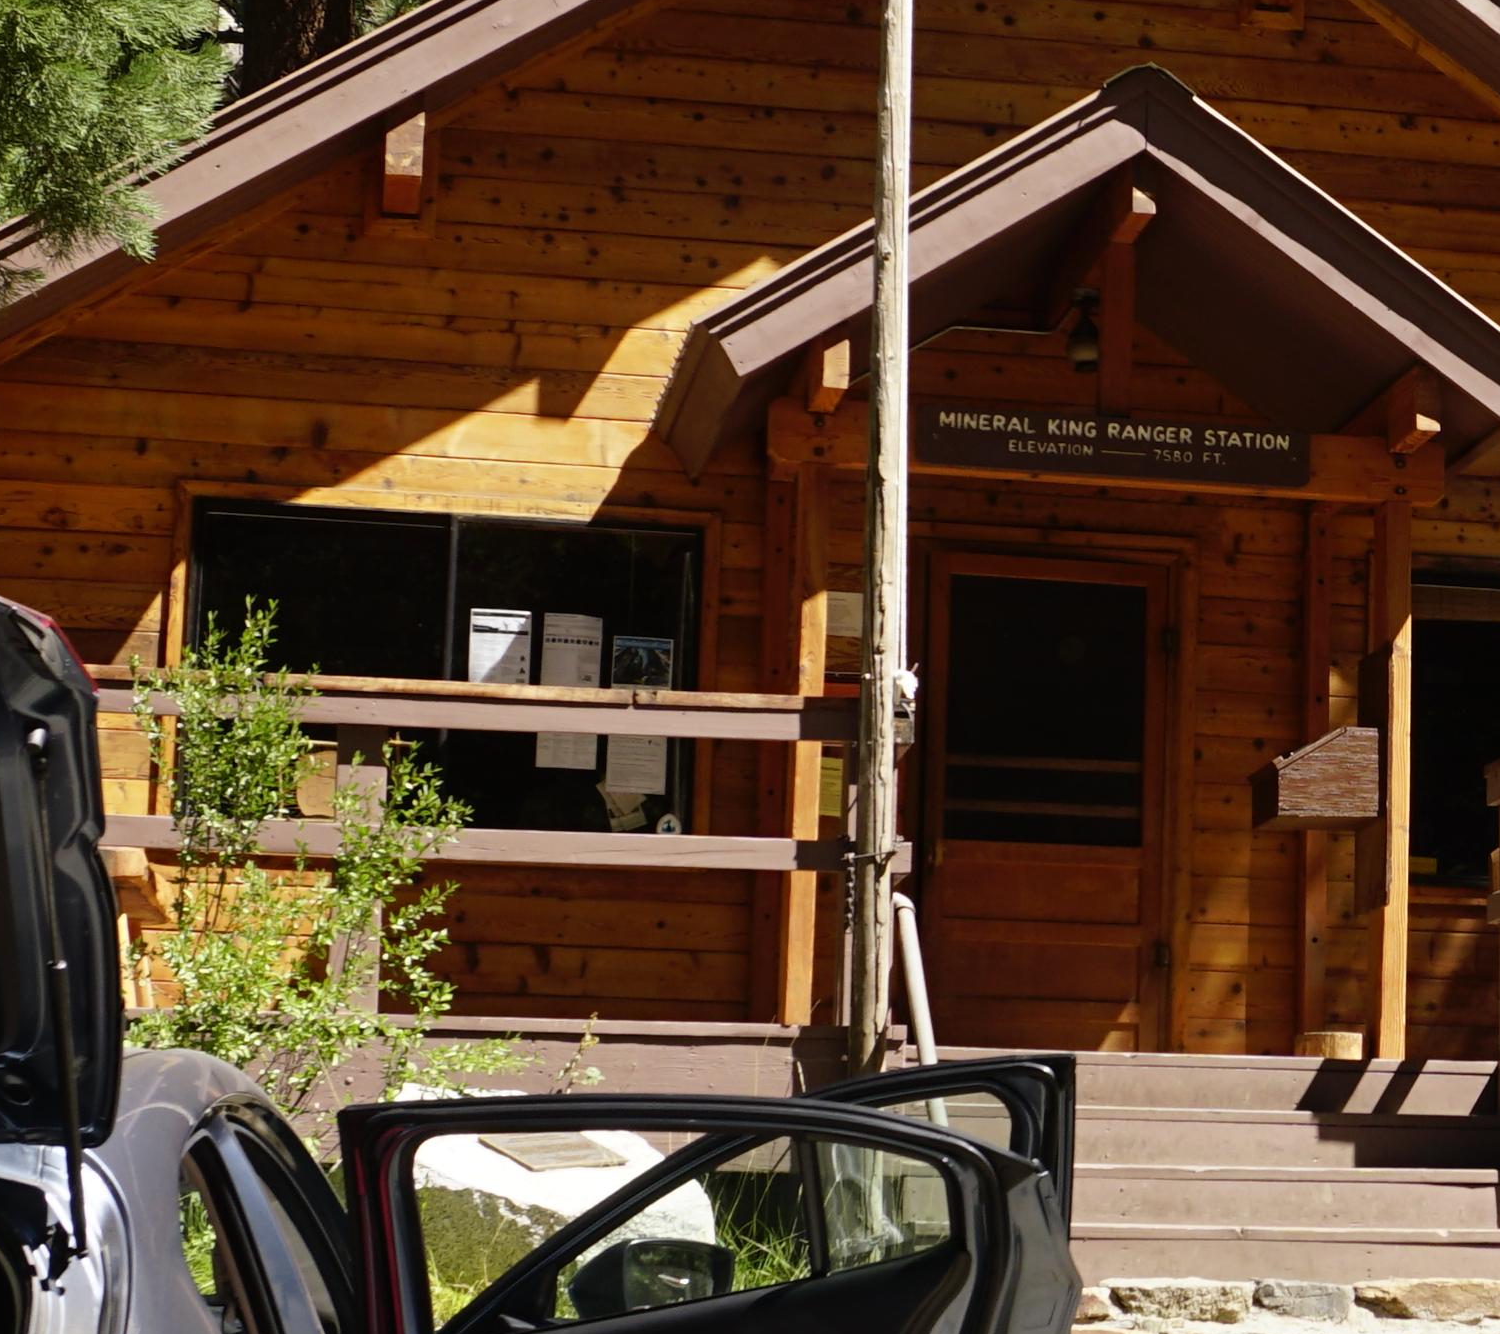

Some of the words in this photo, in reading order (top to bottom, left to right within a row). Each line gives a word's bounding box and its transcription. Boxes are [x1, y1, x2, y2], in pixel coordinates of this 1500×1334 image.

[939, 410, 1035, 436] MINERAL
[1047, 419, 1098, 439] KING
[1107, 422, 1193, 445] RANGER
[1203, 429, 1290, 451] STATION
[1008, 439, 1094, 456] ELEVATION
[1154, 449, 1193, 464] 7580
[1203, 453, 1226, 466] FT.
